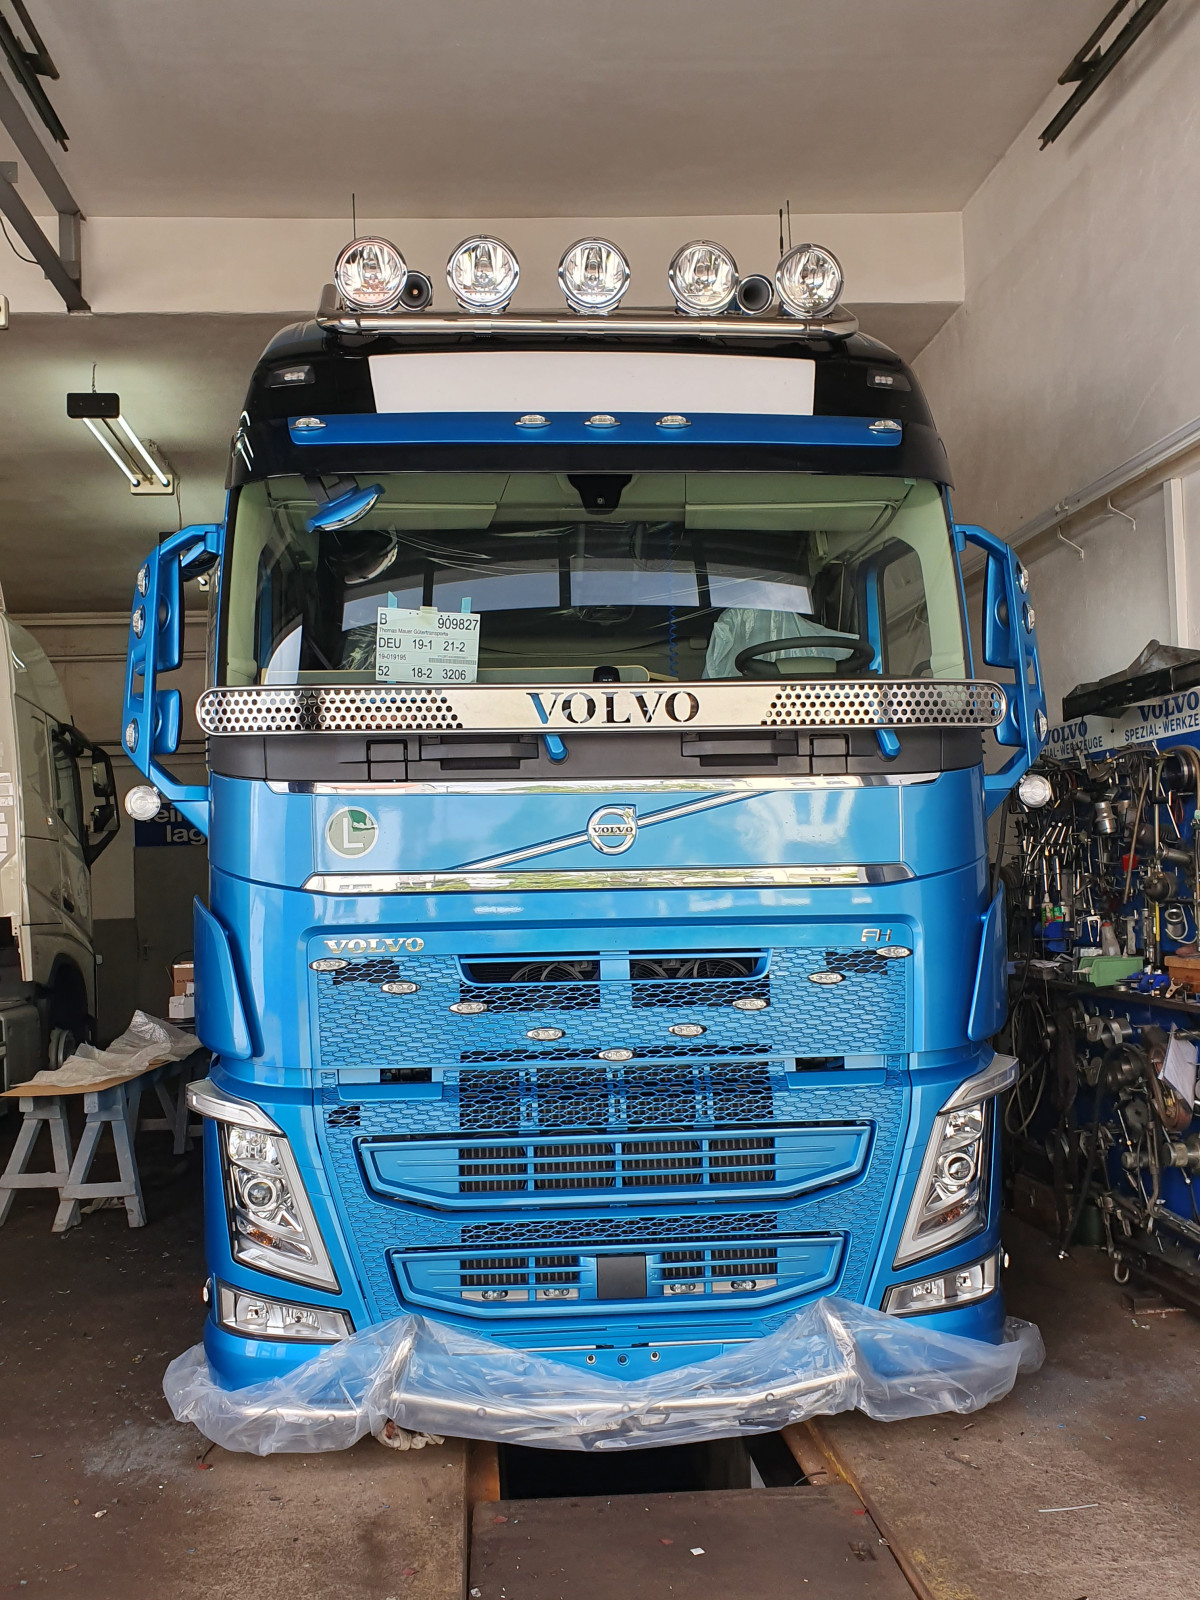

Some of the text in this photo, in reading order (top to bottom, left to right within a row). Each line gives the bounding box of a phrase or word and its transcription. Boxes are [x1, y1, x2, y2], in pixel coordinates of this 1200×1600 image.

[379, 613, 479, 631] B 909827
[378, 637, 466, 652] DEU 19-1 21-2
[377, 665, 467, 680] 52 18-2 3206
[526, 691, 700, 725] VOLVO
[1137, 691, 1200, 722] VOLVO
[592, 826, 634, 834] VOLVO
[324, 937, 425, 954] VOLVO
